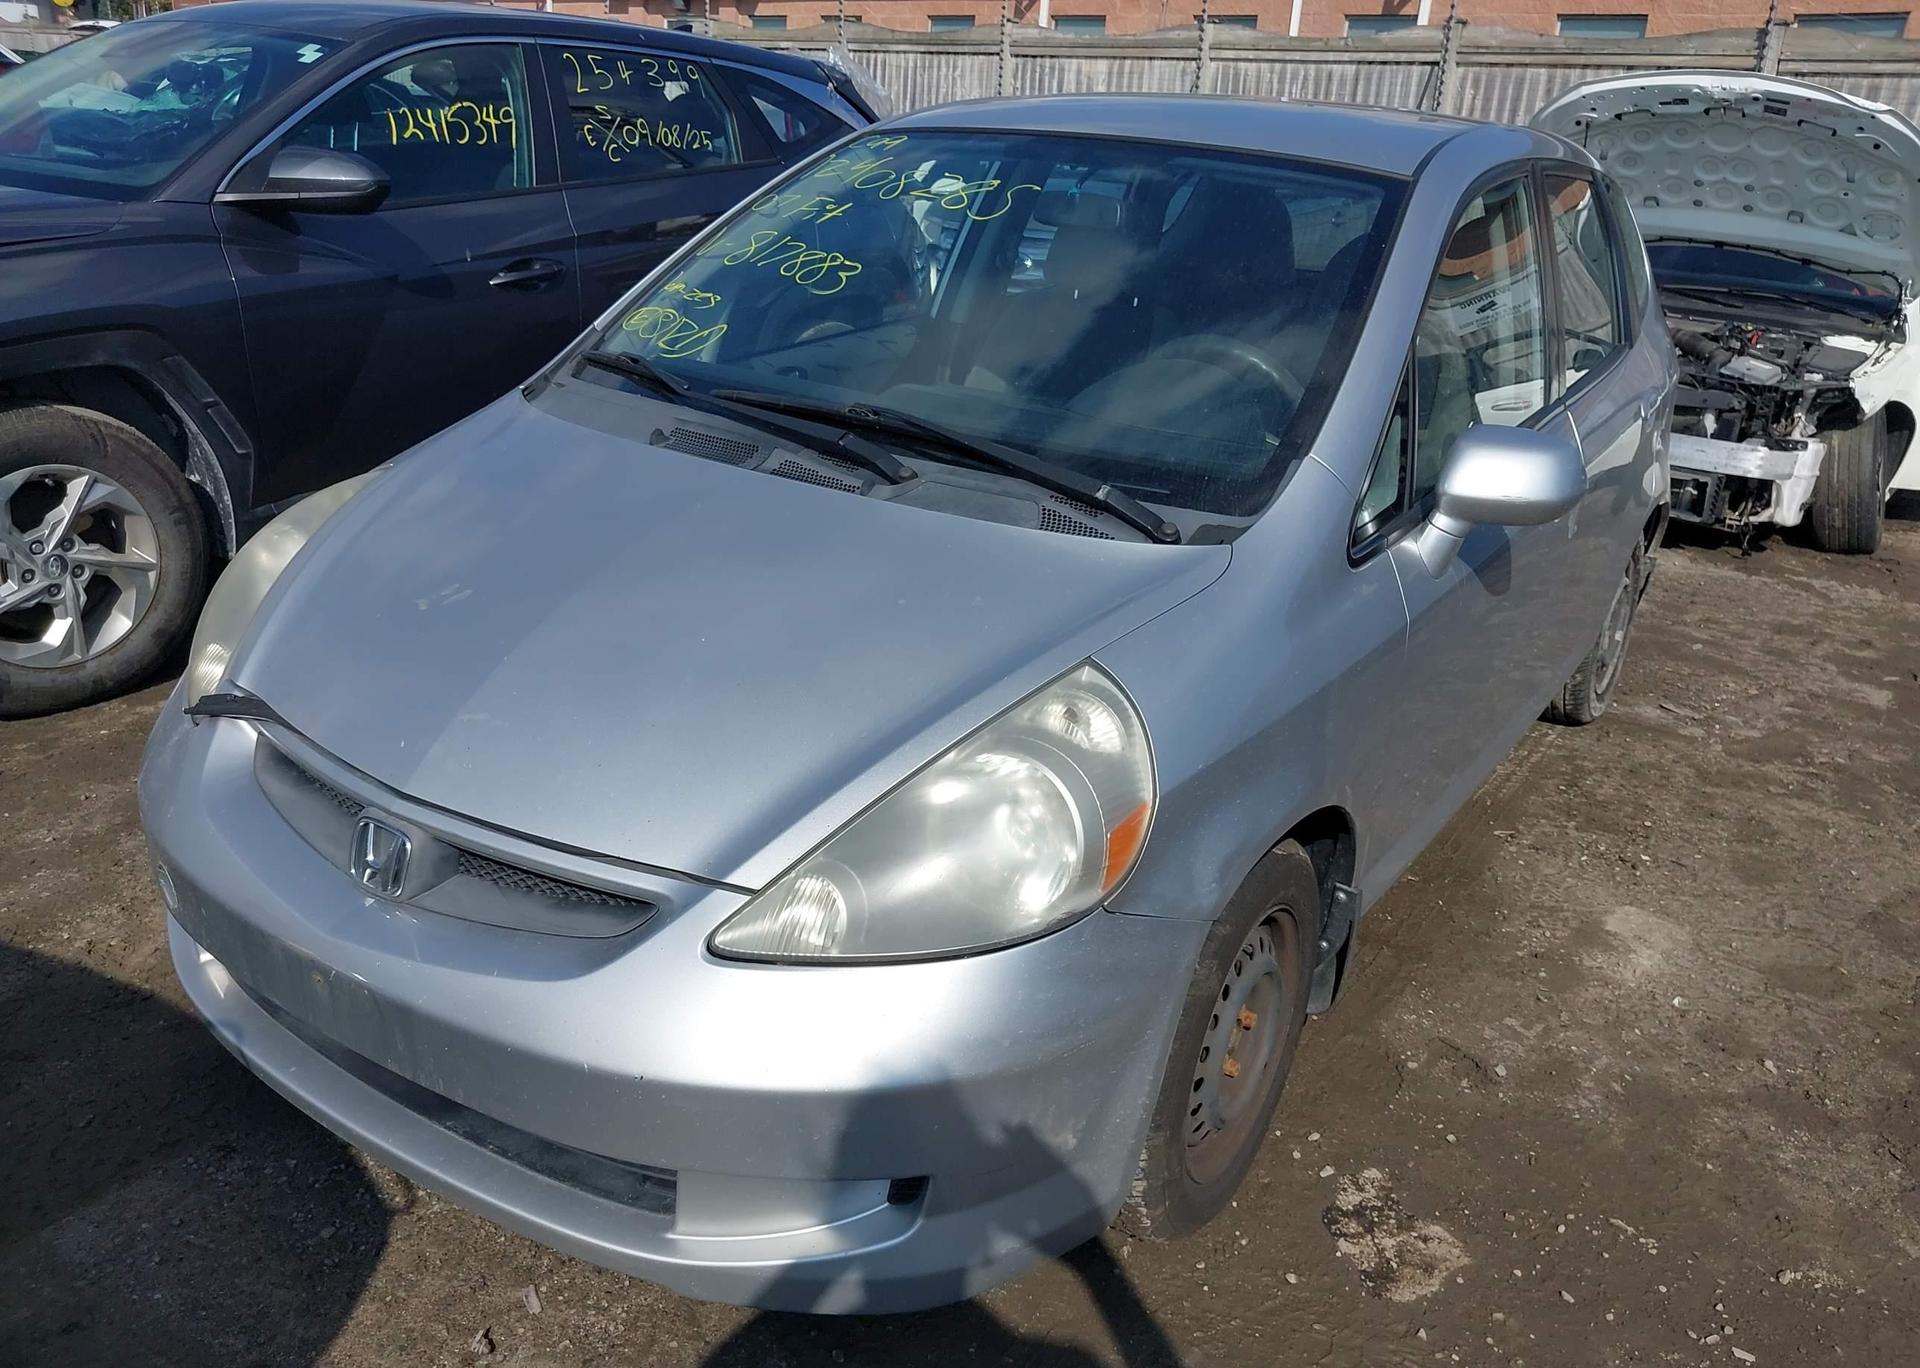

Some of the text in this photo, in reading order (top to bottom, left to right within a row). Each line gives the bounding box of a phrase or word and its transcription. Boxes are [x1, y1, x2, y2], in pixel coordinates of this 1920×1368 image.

[563, 52, 706, 99] 254399
[385, 101, 516, 149] 12415349
[622, 118, 713, 153] 09/08/25
